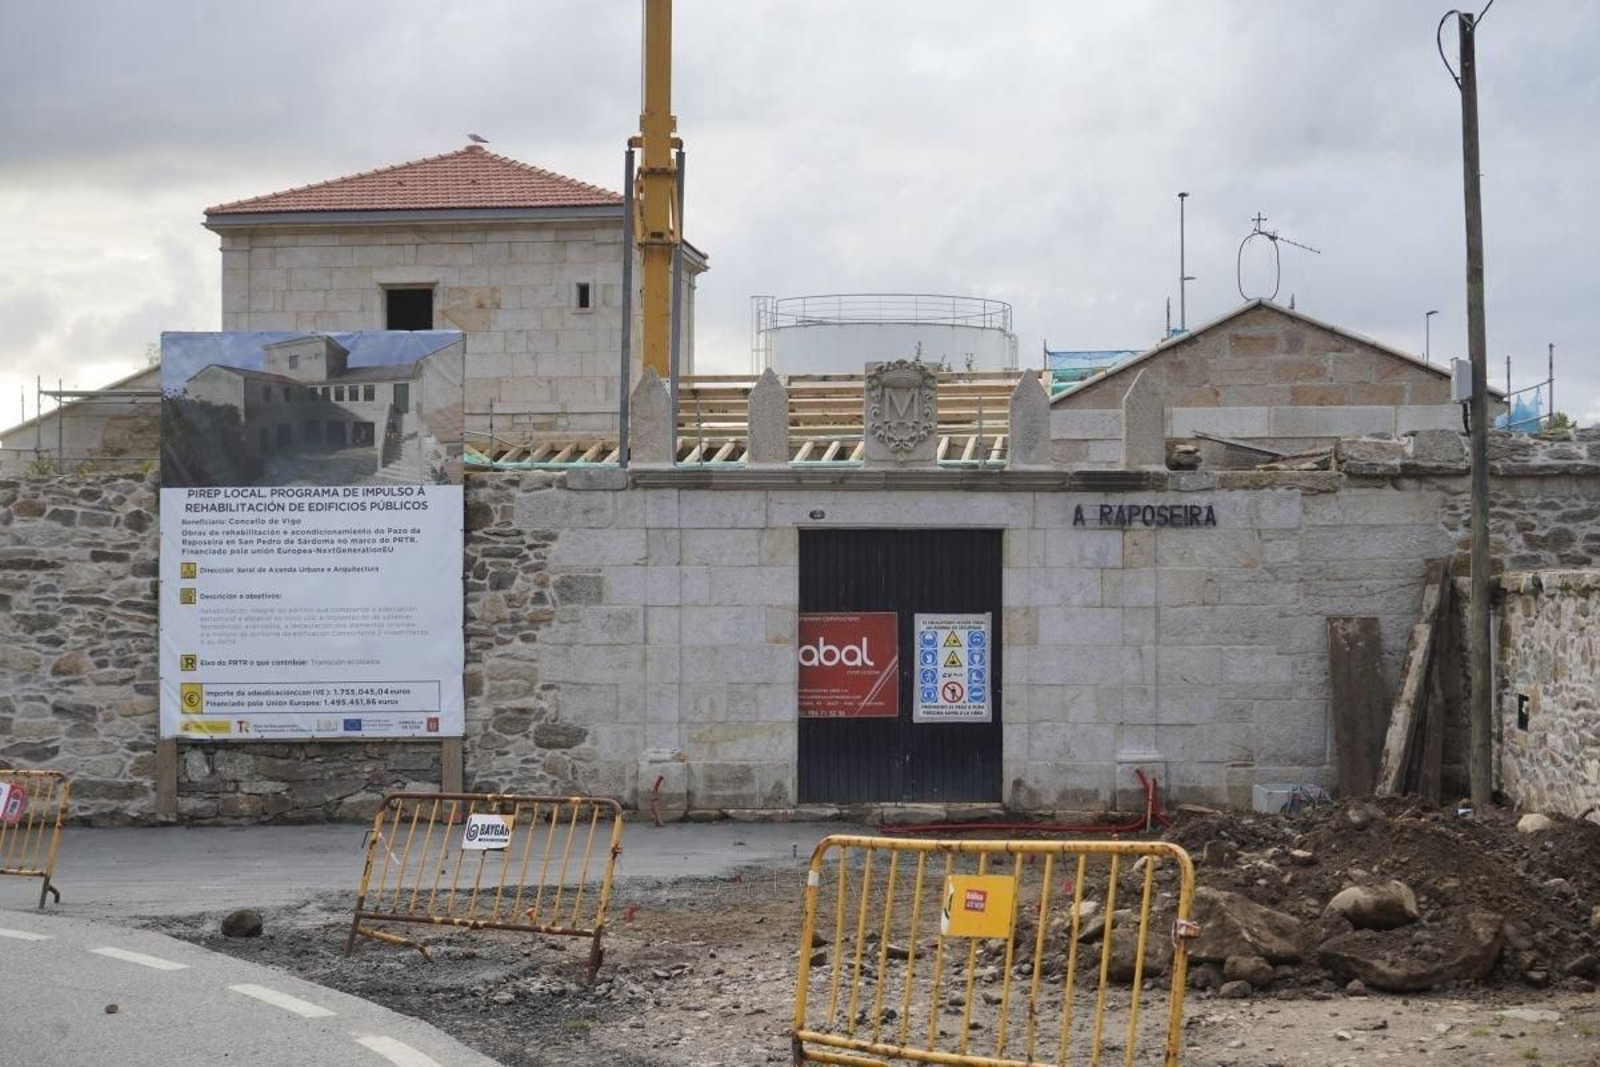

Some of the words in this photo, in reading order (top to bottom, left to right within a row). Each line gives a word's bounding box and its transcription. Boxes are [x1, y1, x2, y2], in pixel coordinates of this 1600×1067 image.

[188, 489, 221, 498] PIREP
[224, 488, 267, 498] LOCAL.
[270, 488, 339, 498] PROGRAMA
[343, 487, 359, 497] DE
[362, 487, 414, 497] IMPULSO
[185, 501, 285, 512] REHABILITACIÓN
[289, 502, 305, 512] DE
[308, 502, 367, 511] EDIFICIOS
[370, 499, 429, 510] PÚBLICOS
[1072, 504, 1085, 526] A
[1099, 504, 1216, 527] RAPOSEIRA
[281, 518, 302, 526] Vigo
[222, 528, 280, 536] rehabilitación
[181, 538, 223, 547] Raposeira
[230, 548, 248, 556] pola
[247, 700, 264, 708] pola
